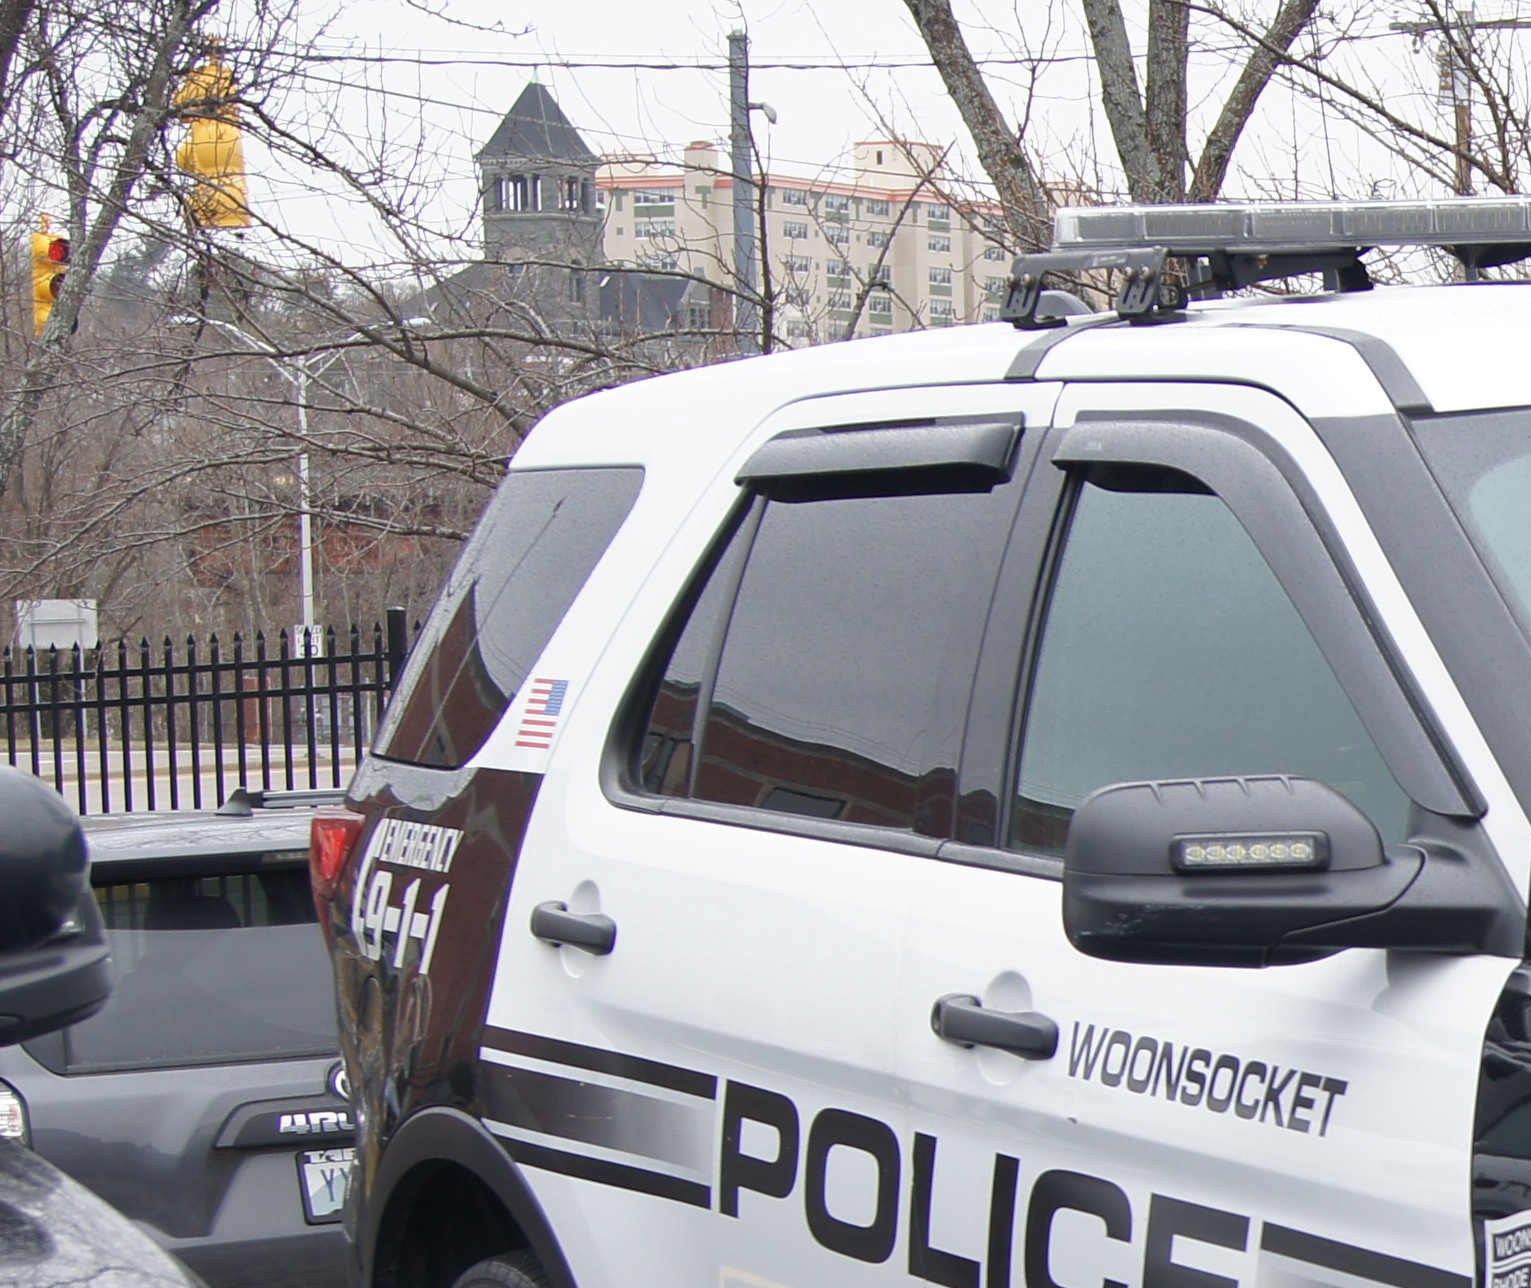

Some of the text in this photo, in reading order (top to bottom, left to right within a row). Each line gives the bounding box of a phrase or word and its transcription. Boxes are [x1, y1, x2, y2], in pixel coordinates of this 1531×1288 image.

[296, 626, 322, 634] SPED
[365, 870, 450, 975] 9-1-1
[1068, 1021, 1349, 1137] WOONSOCKET
